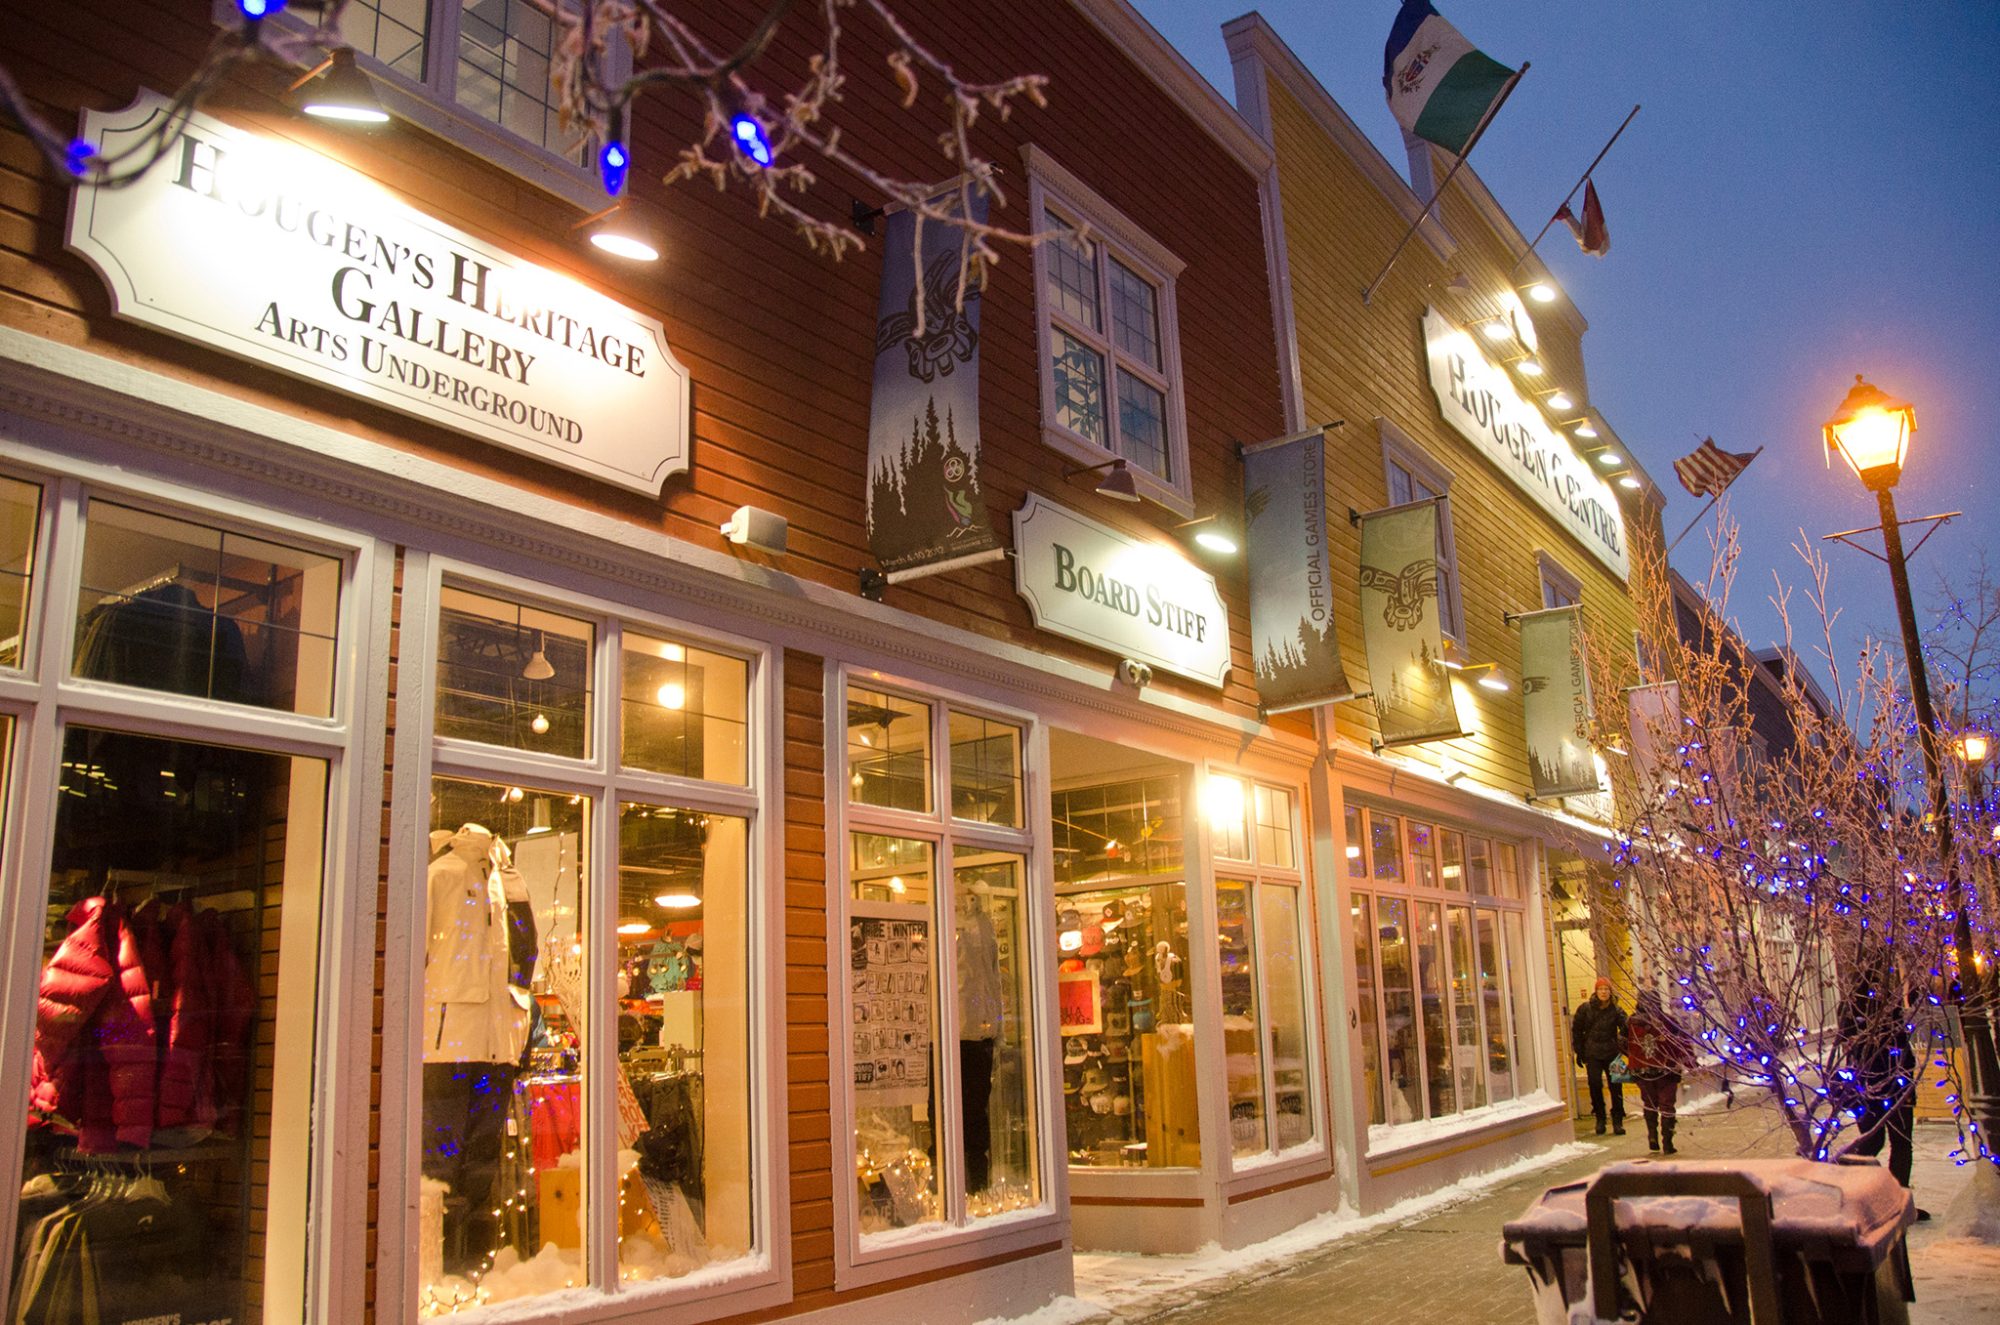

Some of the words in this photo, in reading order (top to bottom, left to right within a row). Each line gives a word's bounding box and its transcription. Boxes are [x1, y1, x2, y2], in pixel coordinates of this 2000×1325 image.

[331, 266, 536, 386] GALLERY
[448, 252, 646, 378] HERITAGE
[256, 301, 349, 361] ARTS
[360, 337, 584, 445] UNDERGROUND
[1303, 444, 1317, 489] STORE
[1448, 352, 1550, 489] HOUGEN
[1551, 452, 1621, 557] CENTRE
[1305, 492, 1320, 546] GAMES
[1053, 542, 1140, 617] BOARD
[1146, 583, 1208, 643] STIFF
[1307, 549, 1323, 622] OFFICIAL
[1569, 647, 1582, 686] GAME
